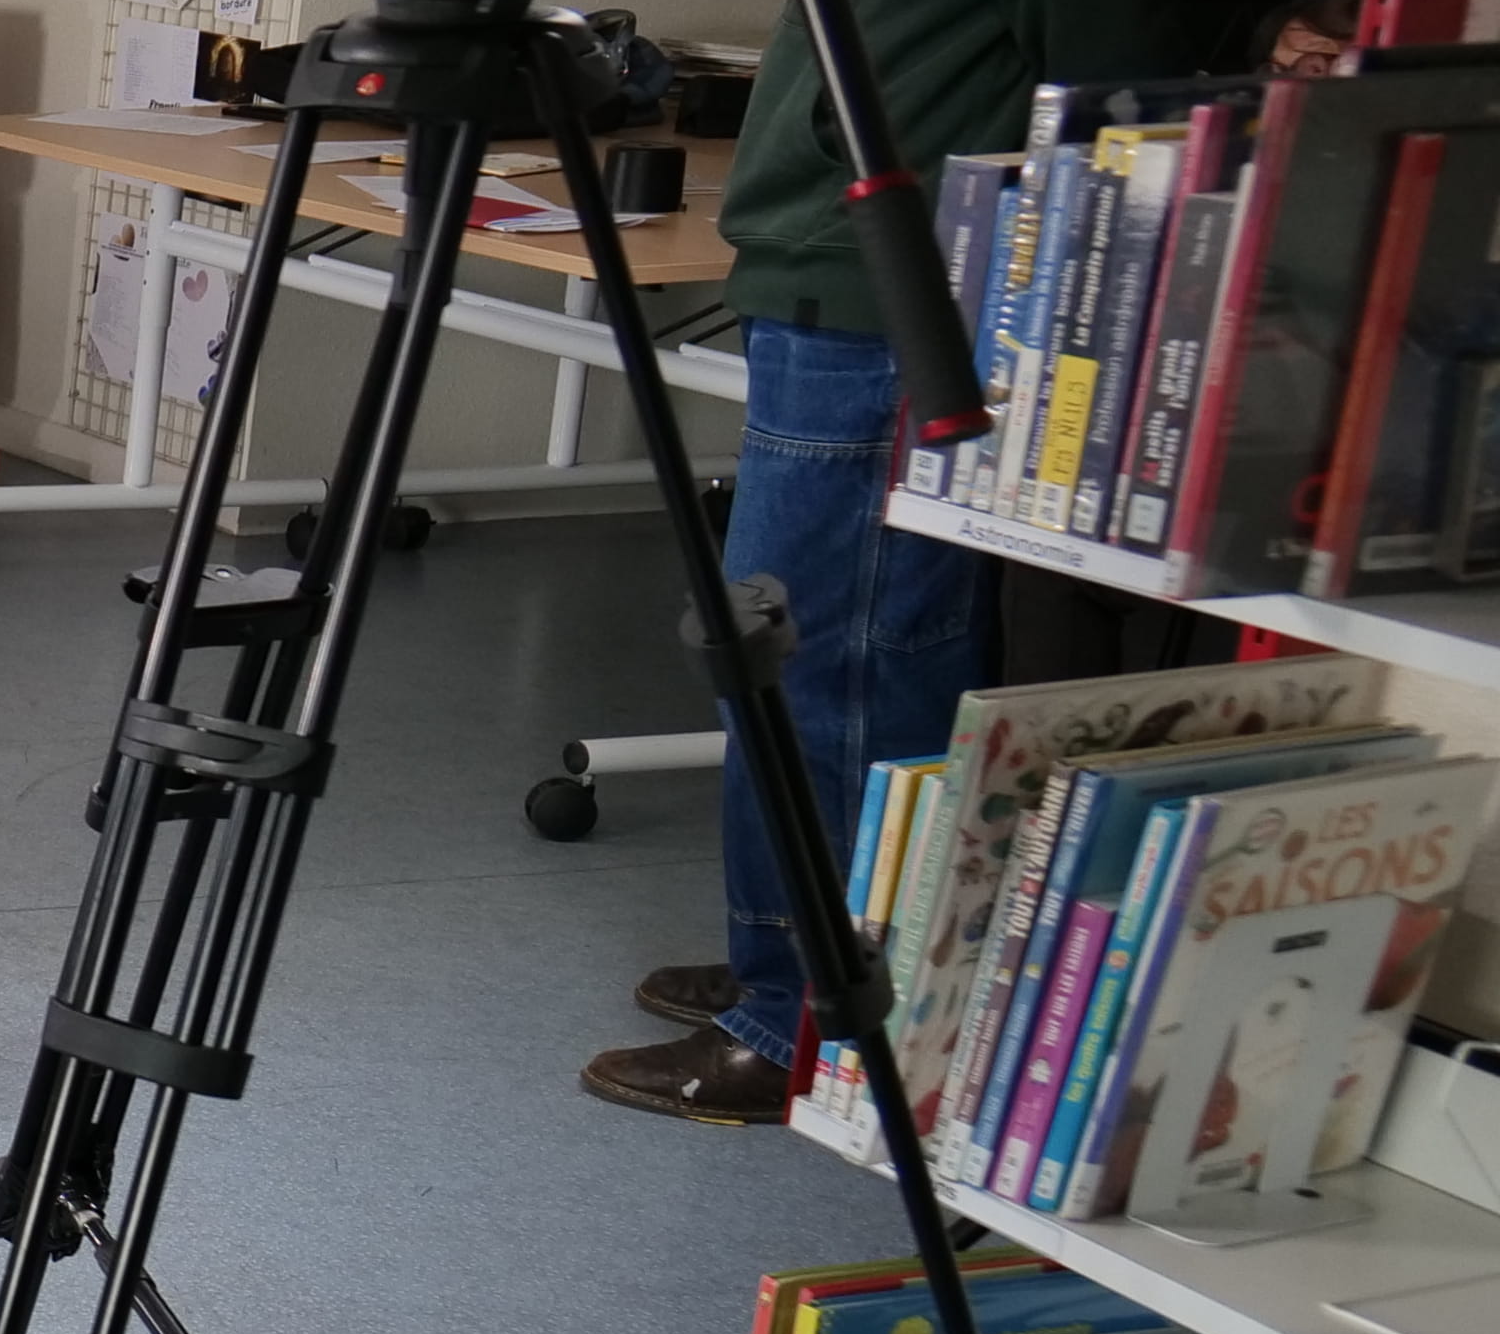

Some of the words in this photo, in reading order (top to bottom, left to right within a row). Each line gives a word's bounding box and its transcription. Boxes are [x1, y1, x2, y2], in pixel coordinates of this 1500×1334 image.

[1075, 255, 1104, 326] Conquête
[1091, 183, 1115, 252] spatiale
[1091, 352, 1123, 445] Profession
[959, 519, 1086, 568] Astronomie
[1024, 777, 1071, 881] L'AUTOMNE
[1064, 783, 1095, 845] L'HIVER
[1316, 800, 1380, 843] LES
[1204, 823, 1456, 925] SAISONS
